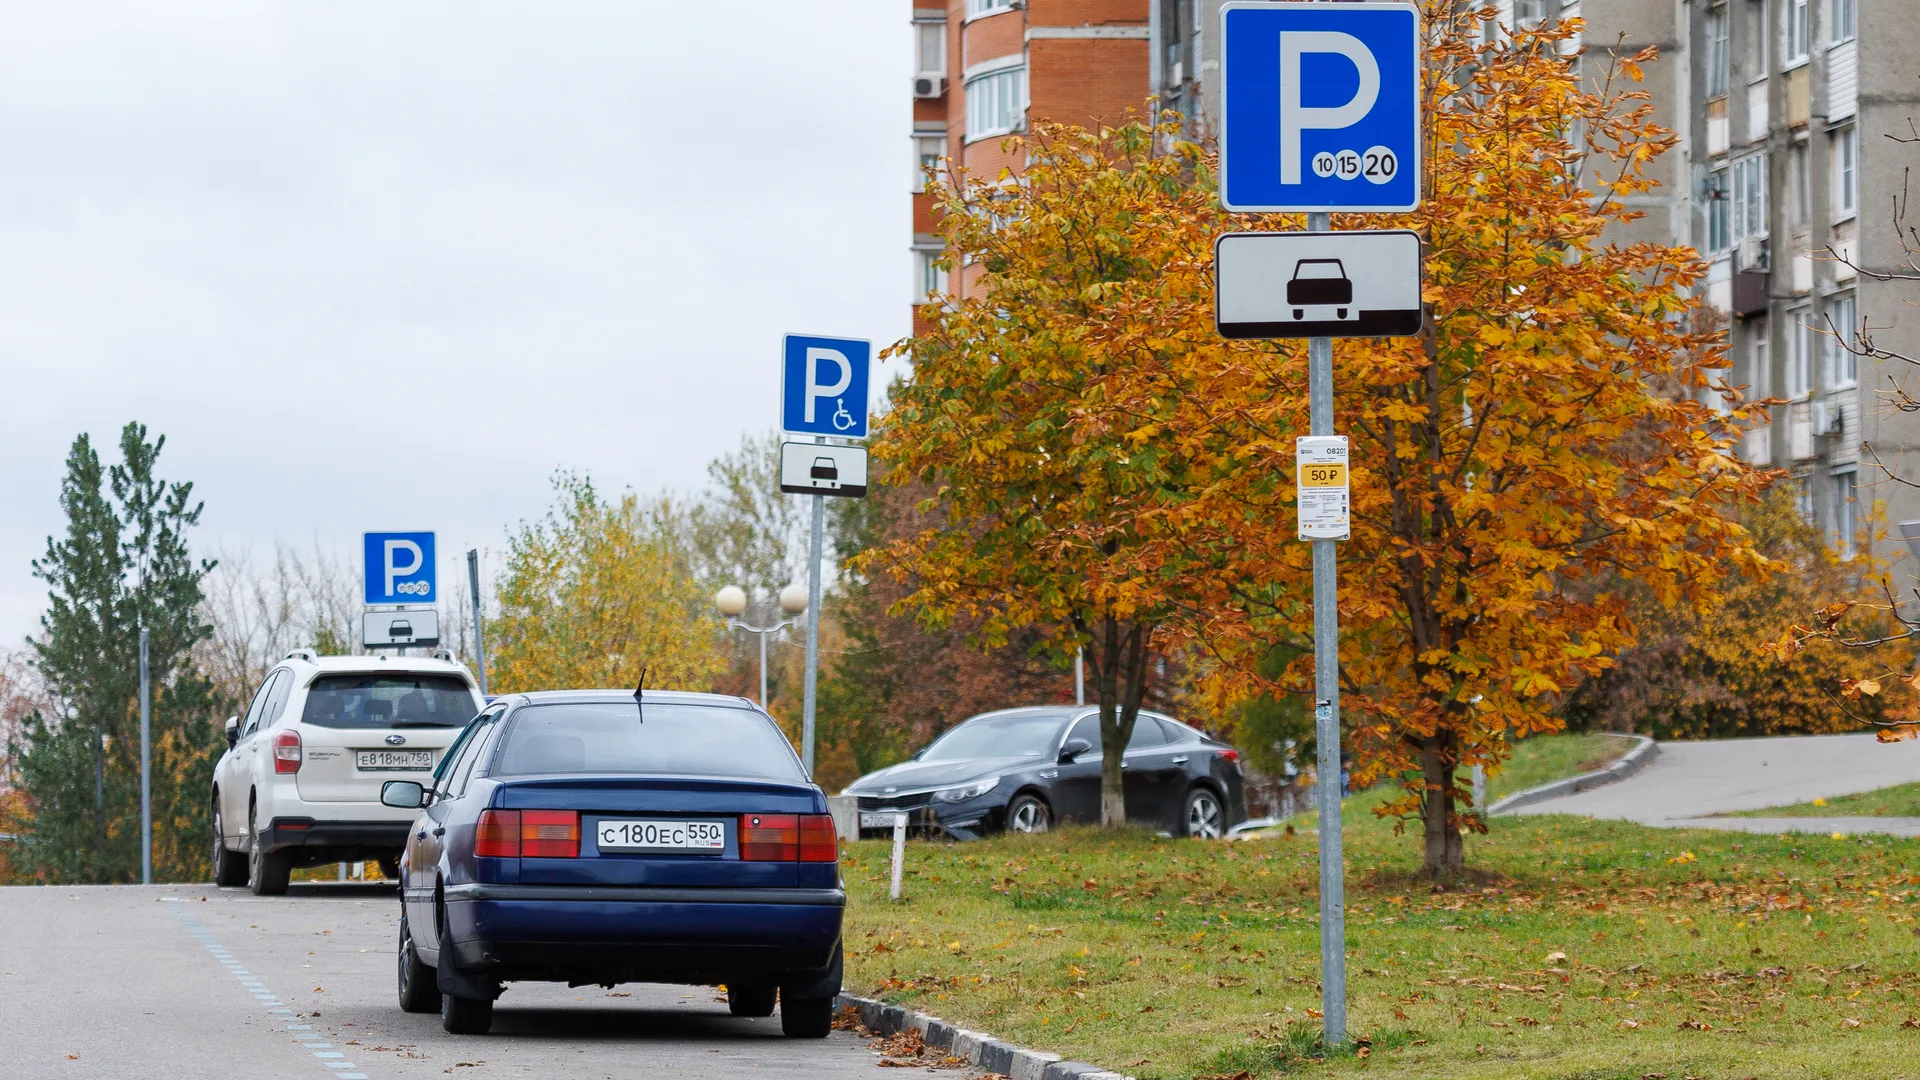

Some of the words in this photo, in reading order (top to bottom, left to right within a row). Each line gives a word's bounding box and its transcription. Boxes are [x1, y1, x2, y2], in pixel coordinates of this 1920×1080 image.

[1280, 31, 1381, 184] P
[1317, 158, 1333, 172] 10
[1339, 156, 1358, 174] 15
[1365, 154, 1395, 176] 20
[804, 347, 852, 423] P
[1311, 470, 1327, 481] 50
[384, 539, 423, 596] P
[416, 584, 429, 592] 20
[410, 752, 429, 762] 750
[688, 824, 719, 839] 550
